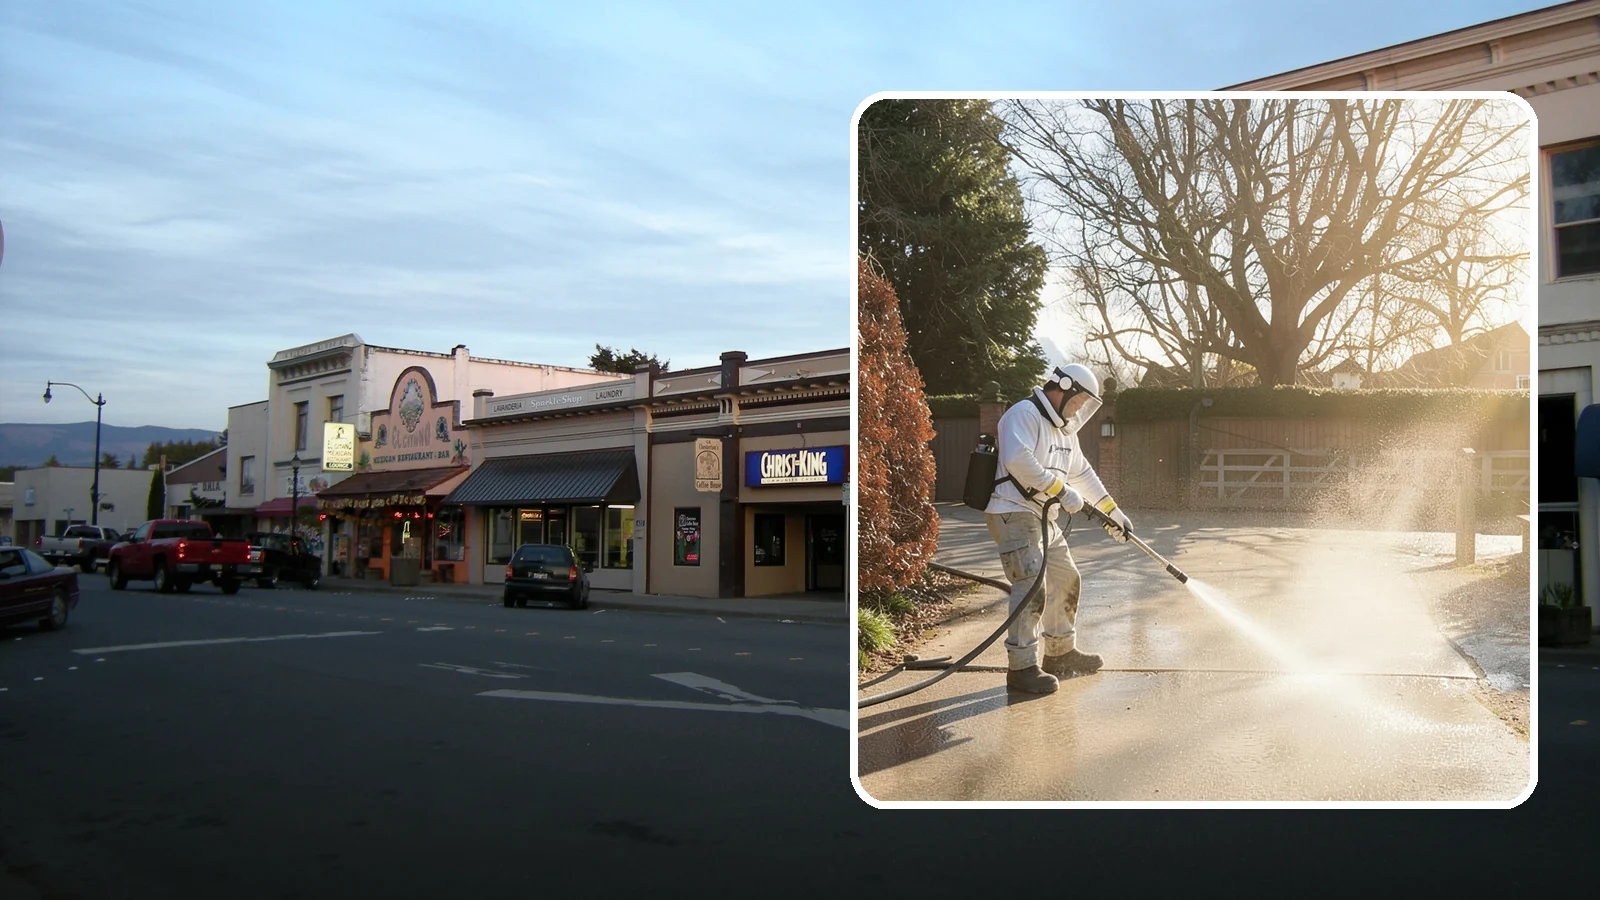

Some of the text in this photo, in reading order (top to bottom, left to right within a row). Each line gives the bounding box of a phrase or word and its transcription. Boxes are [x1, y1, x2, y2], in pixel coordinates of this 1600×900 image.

[531, 394, 582, 408] Sparkle Shop
[595, 389, 623, 400] LAUNDRY
[493, 402, 522, 412] LAVANDERIA
[374, 450, 450, 464] MEXICAN RESTAURANT BAR
[799, 450, 827, 476] KING
